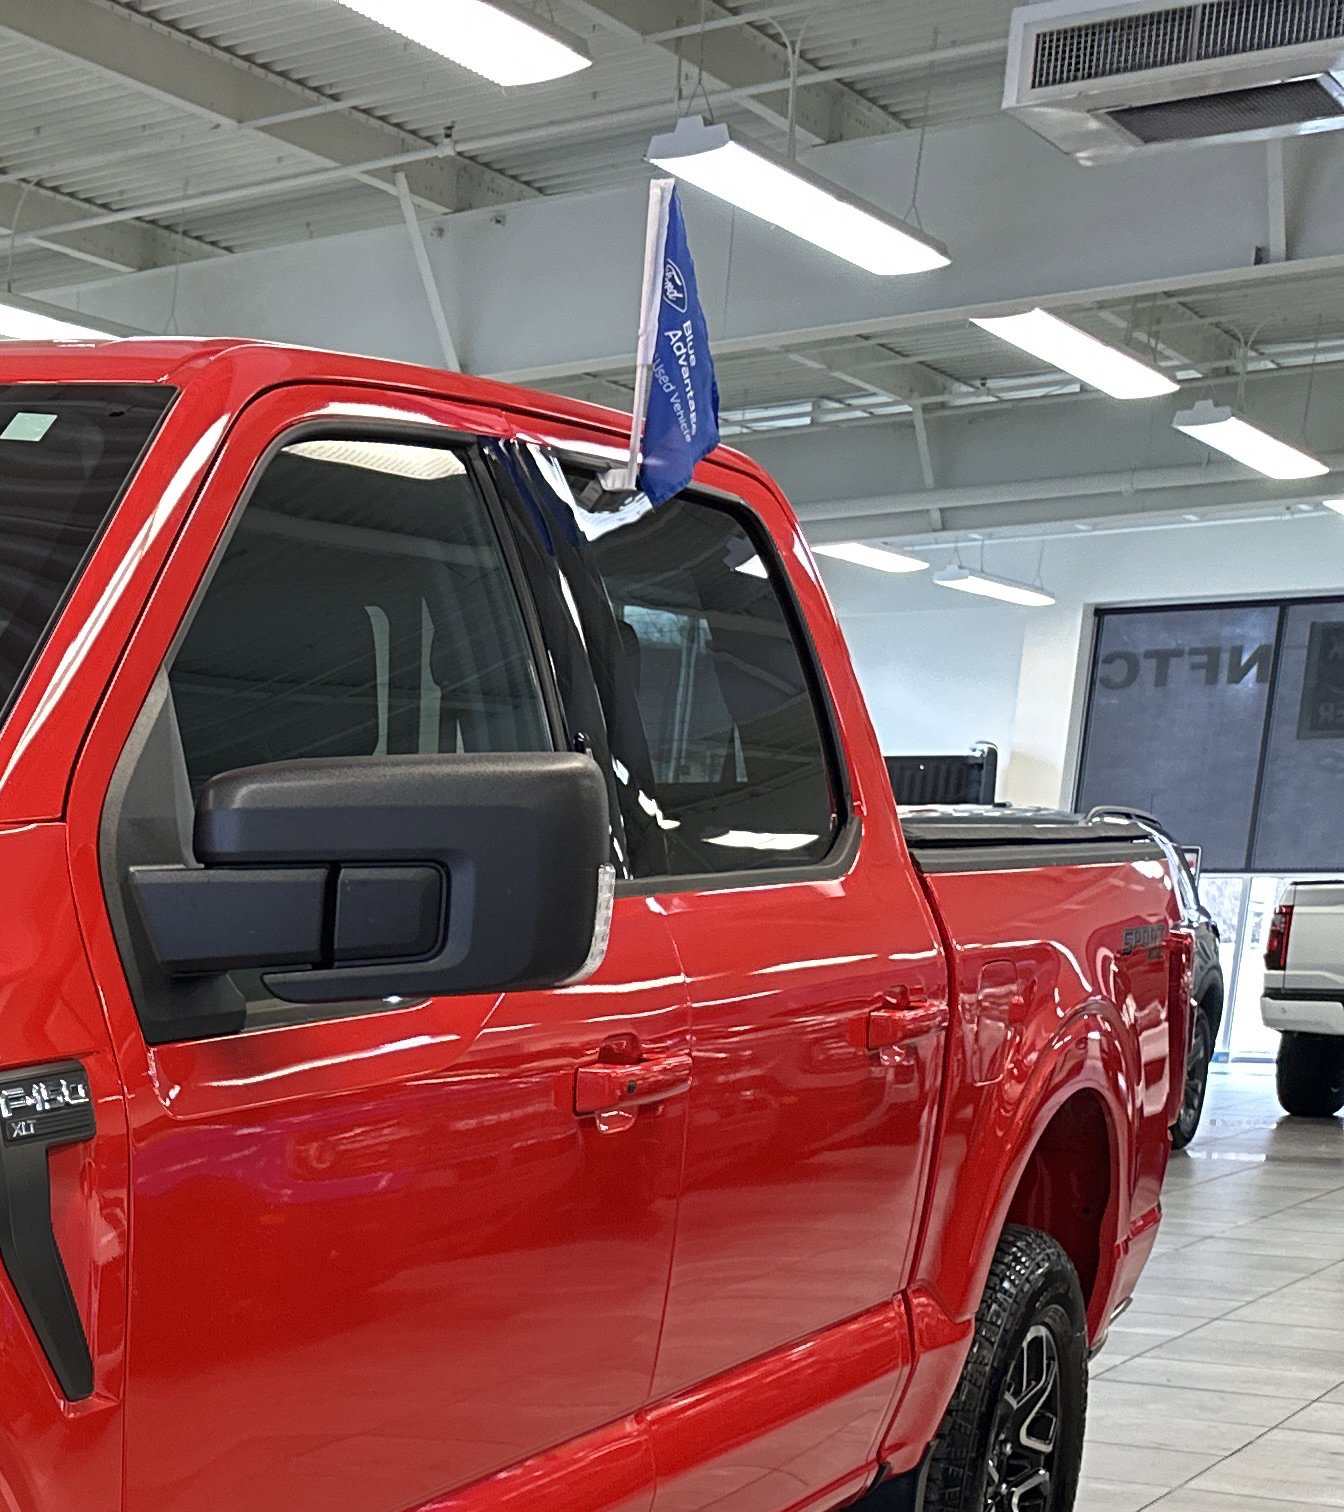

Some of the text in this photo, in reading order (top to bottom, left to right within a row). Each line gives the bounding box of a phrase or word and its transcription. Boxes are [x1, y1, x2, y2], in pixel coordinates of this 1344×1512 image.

[683, 320, 696, 367] Blue
[652, 358, 691, 443] Used Vehicle
[664, 330, 696, 435] Advantage
[12, 1119, 37, 1138] XLT
